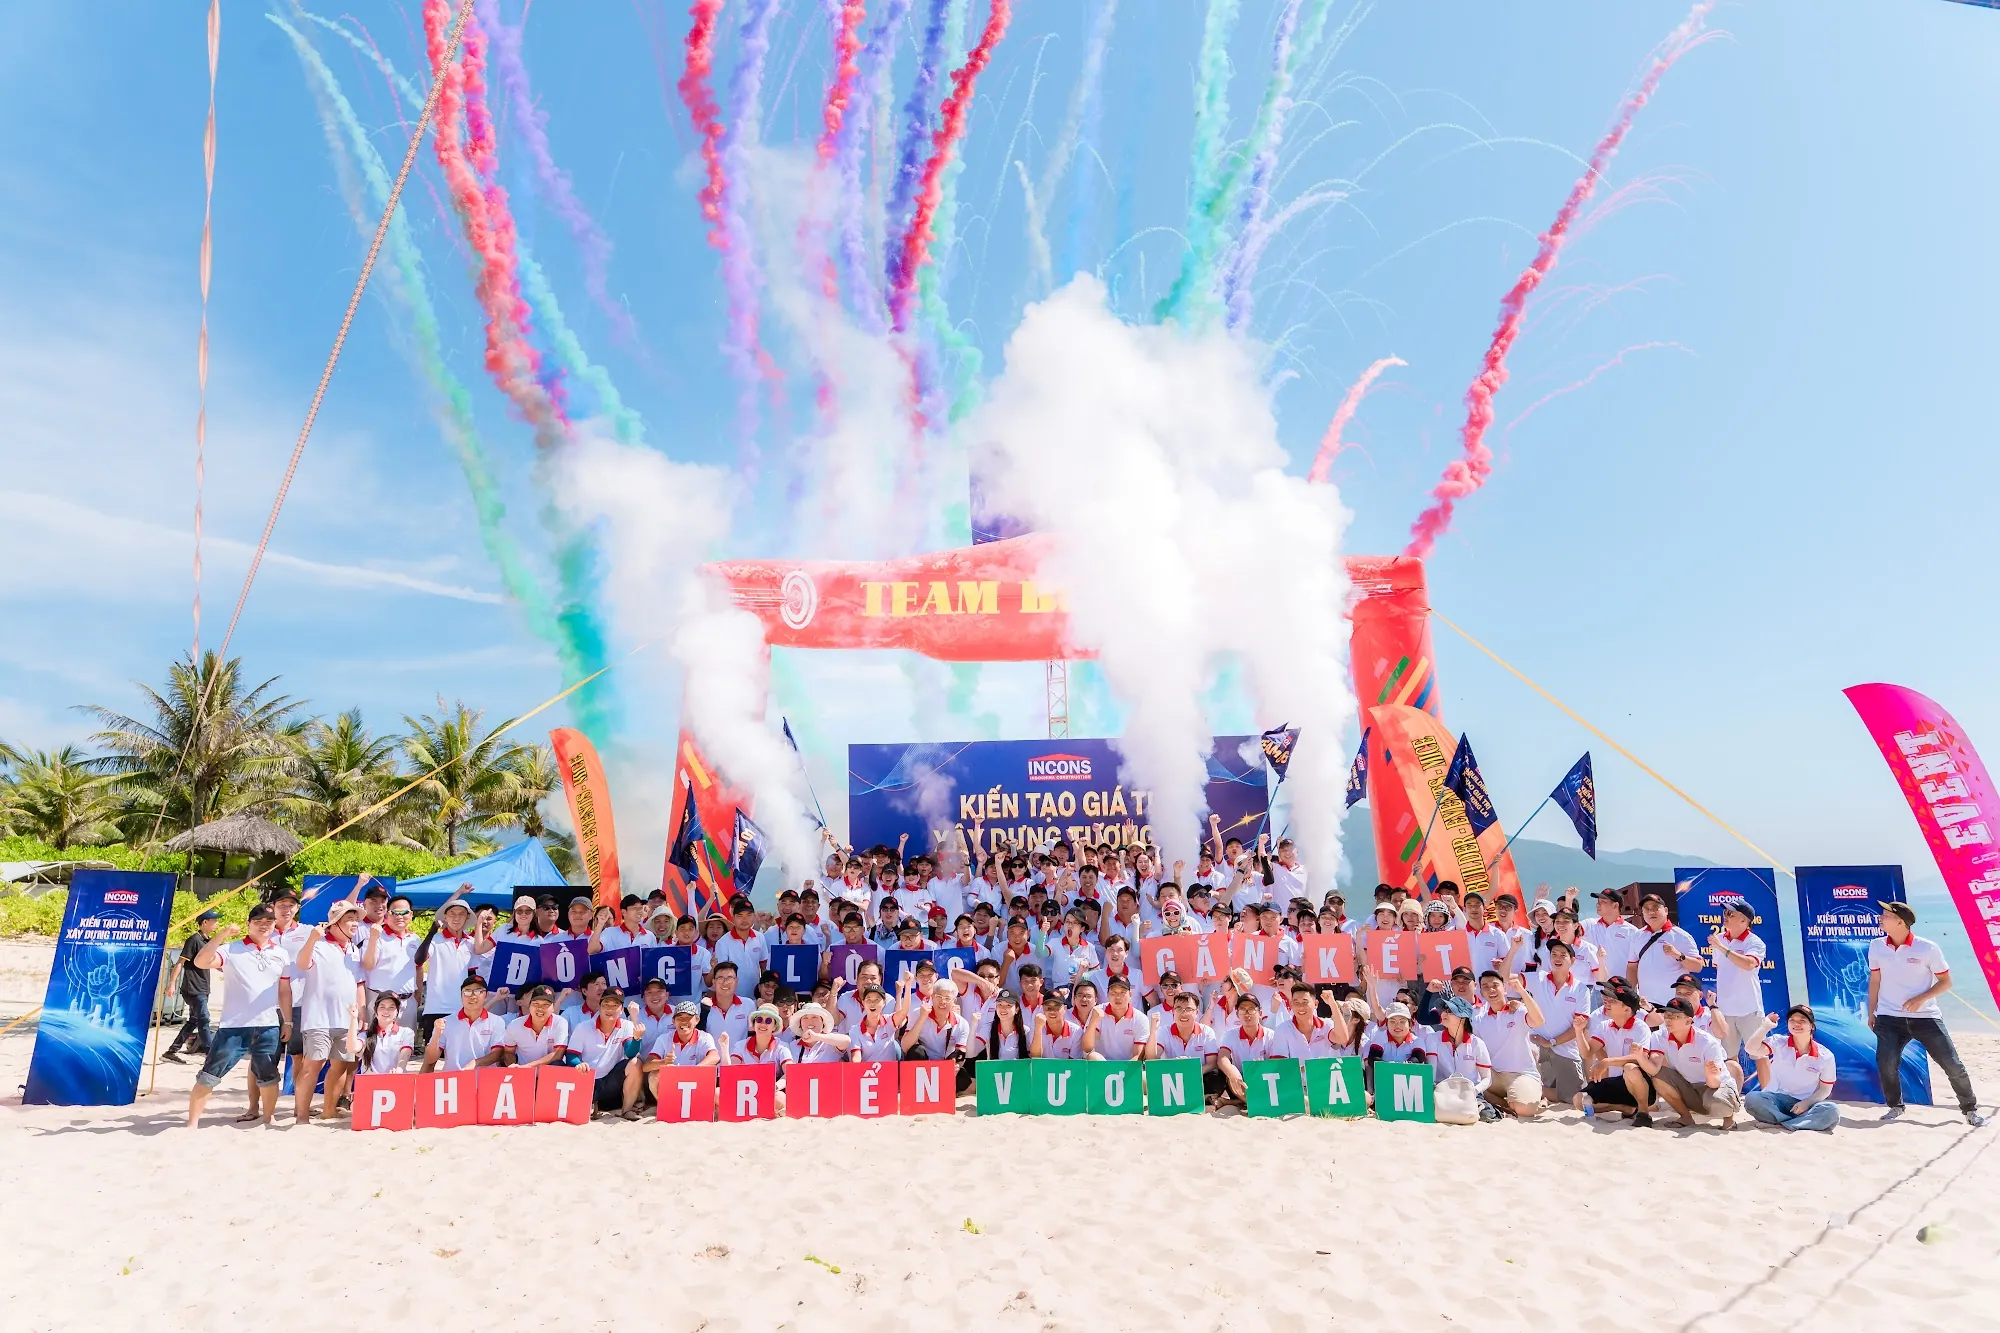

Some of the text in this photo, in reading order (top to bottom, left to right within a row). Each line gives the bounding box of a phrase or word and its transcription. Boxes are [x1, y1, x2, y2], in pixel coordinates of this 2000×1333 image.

[860, 580, 1001, 617] TEAM
[1411, 735, 1447, 771] MICE
[1028, 759, 1092, 775] INCONS
[1893, 730, 1995, 849] EVENT
[960, 784, 1019, 820] KIẾN
[1025, 790, 1077, 823] TẠO
[1082, 785, 1128, 818] GIÁ
[104, 893, 139, 901] INCONS
[1832, 888, 1868, 896] INCONS
[120, 918, 134, 929] GIÁ
[136, 920, 149, 930] TRỊ
[1698, 915, 1721, 924] TEAM
[1857, 913, 1872, 924] GIÁ
[66, 929, 84, 940] XÂY
[142, 931, 157, 941] LAI
[1807, 925, 1824, 936] XÂY
[1319, 933, 1453, 978] KẾT
[506, 942, 676, 989] ĐỒNG
[371, 1058, 1425, 1127] PHÁT TRIỂN VƯƠN TẦM
